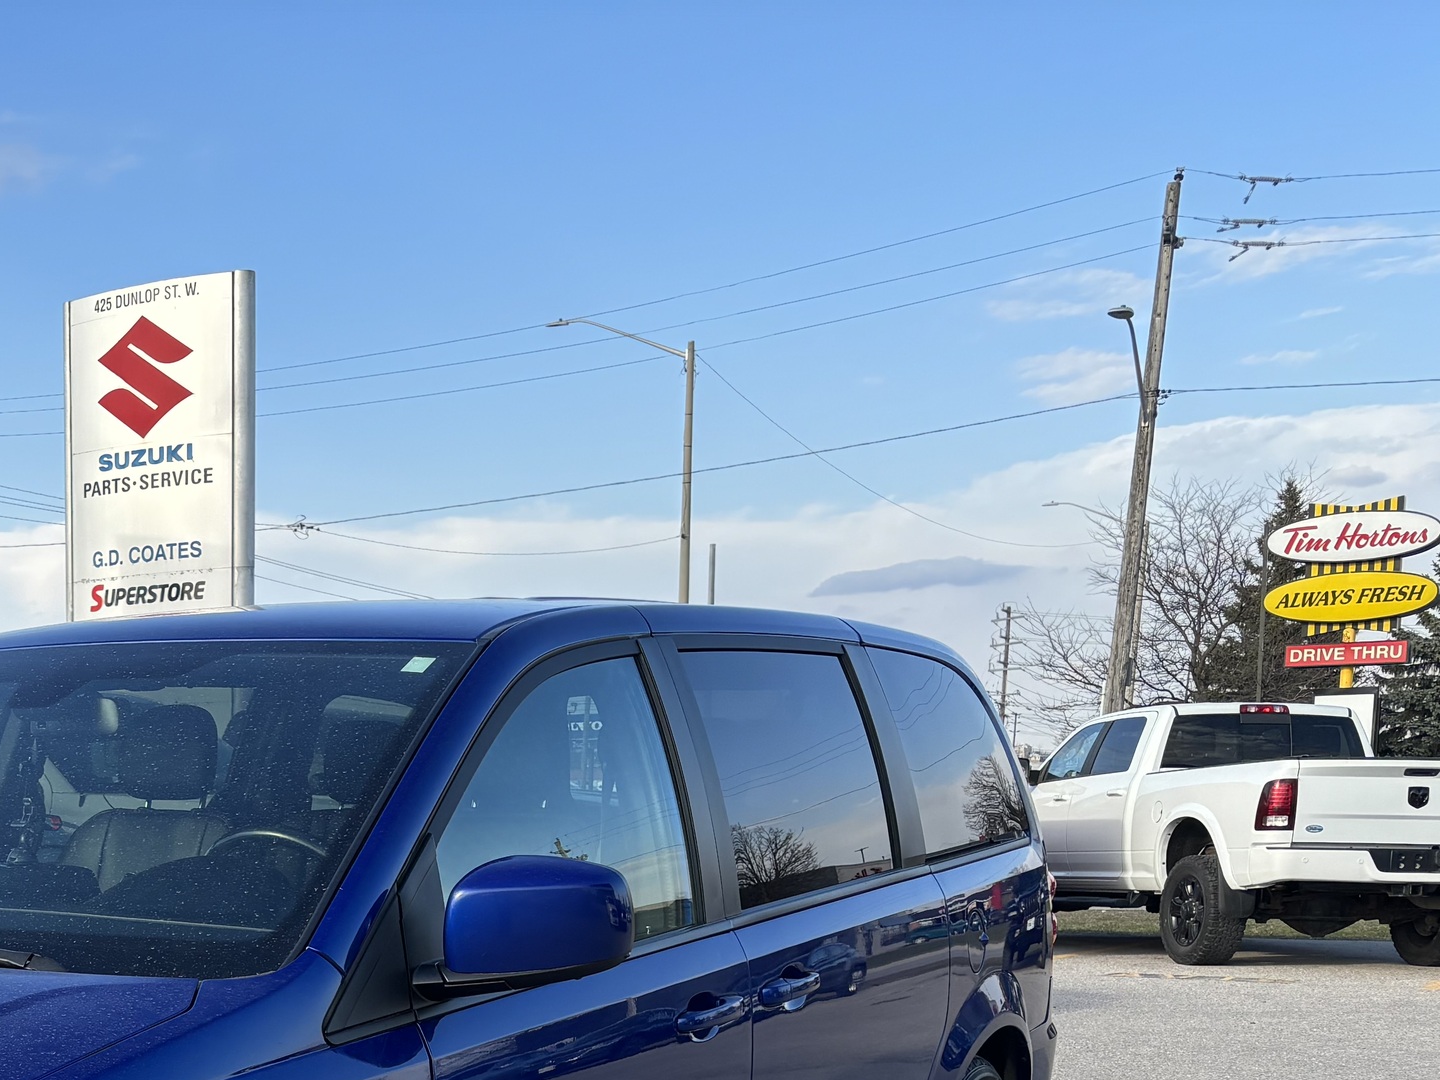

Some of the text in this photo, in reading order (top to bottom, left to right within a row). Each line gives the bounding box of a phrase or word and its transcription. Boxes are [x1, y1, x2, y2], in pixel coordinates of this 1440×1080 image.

[94, 281, 200, 313] 425 DUNLOP ST. W.
[98, 442, 194, 472] SUZUKI
[1283, 522, 1428, 555] Tim Hortons
[92, 540, 203, 568] G.D. COATES
[90, 580, 206, 613] SUPERSTORE
[1275, 584, 1428, 609] ALWAYS FRESH
[1289, 644, 1403, 663] DRIVE THRU
